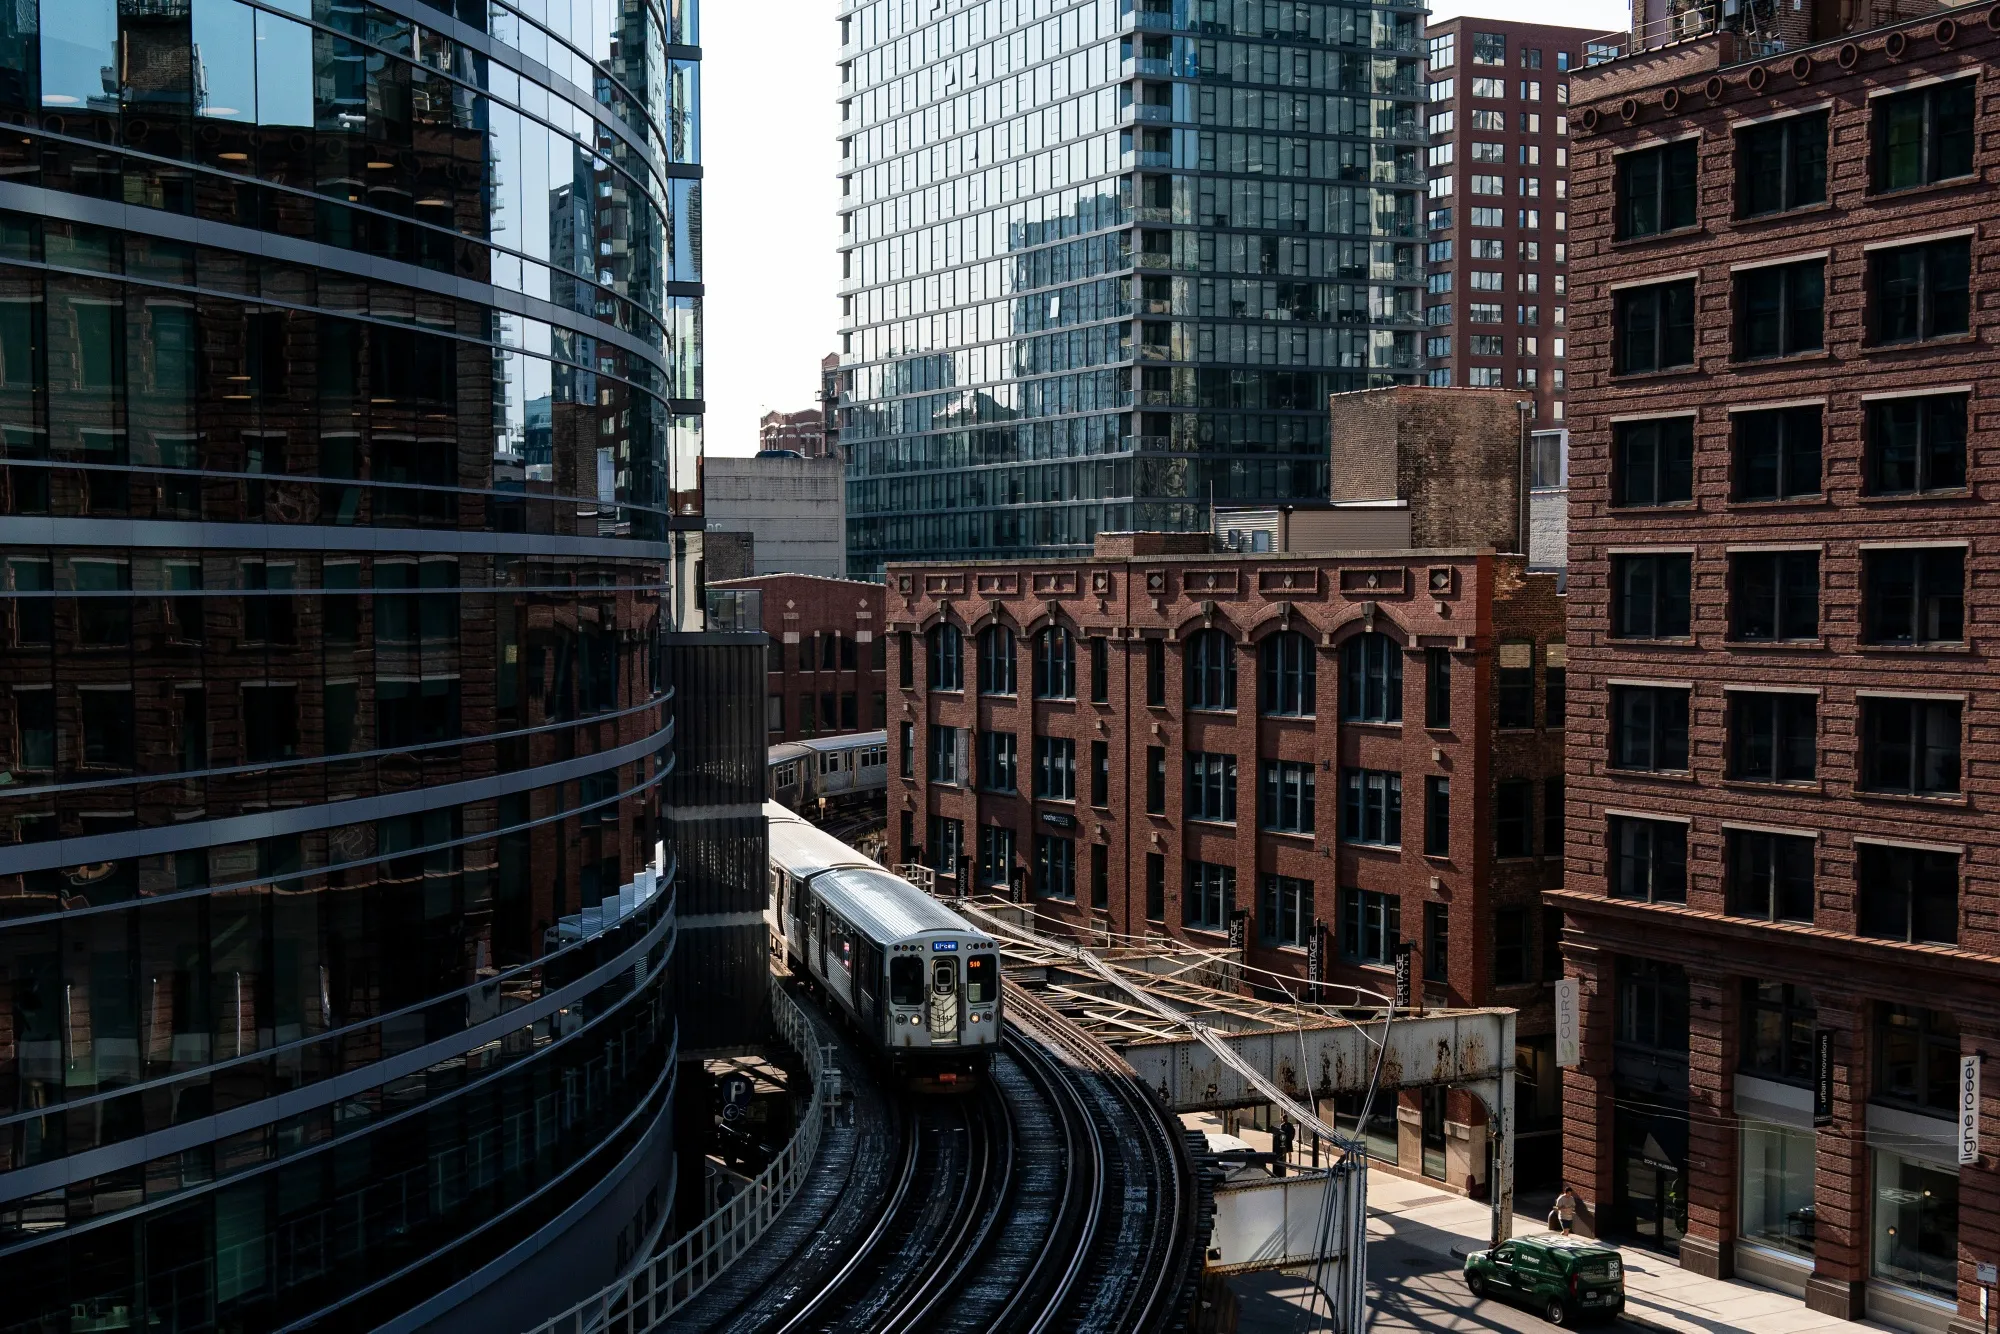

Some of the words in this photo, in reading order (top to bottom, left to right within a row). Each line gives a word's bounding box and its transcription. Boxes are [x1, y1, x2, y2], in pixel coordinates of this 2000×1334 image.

[1230, 919, 1239, 948] TAGE
[1309, 934, 1317, 990] HERITAGE
[1560, 985, 1571, 1039] CURO
[1820, 1034, 1828, 1079] innovations
[730, 1081, 747, 1102] P
[1964, 1059, 1975, 1111] roset
[1961, 1114, 1977, 1161] ligne
[1609, 1262, 1618, 1270] DO
